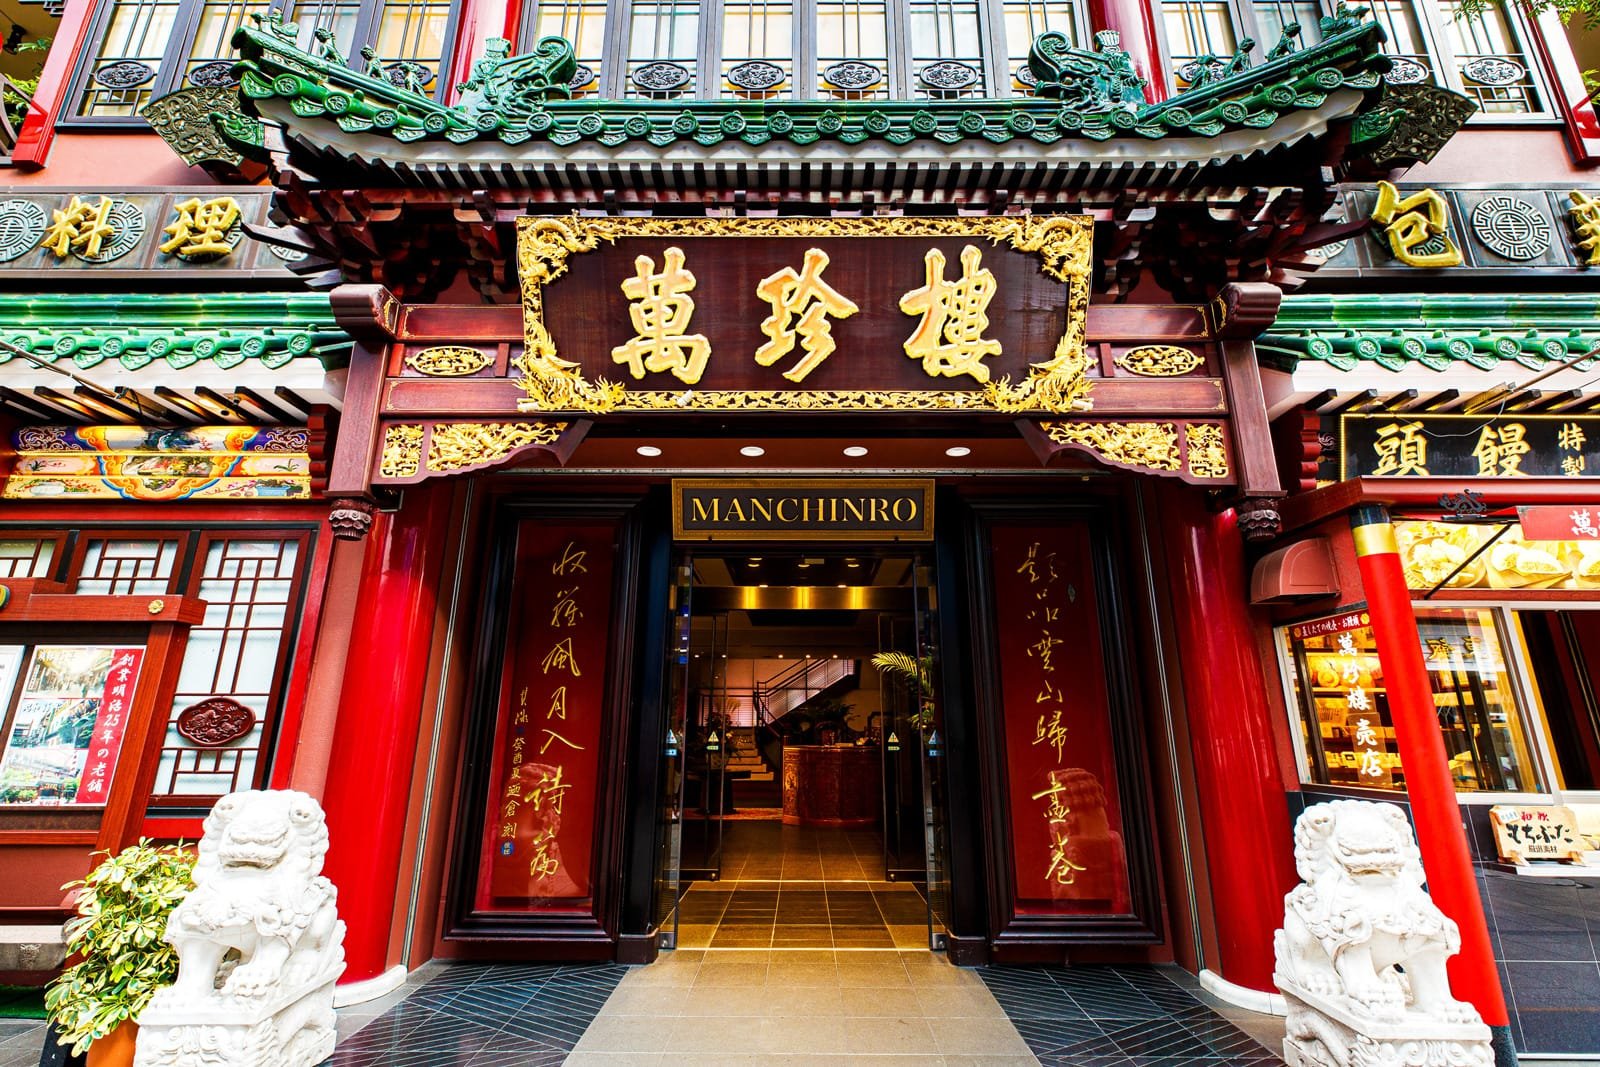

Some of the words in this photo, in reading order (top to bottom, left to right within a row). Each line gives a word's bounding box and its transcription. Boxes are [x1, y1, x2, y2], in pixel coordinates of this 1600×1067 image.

[611, 244, 1003, 385] 萬珍樓
[691, 496, 918, 523] MANCHINRO
